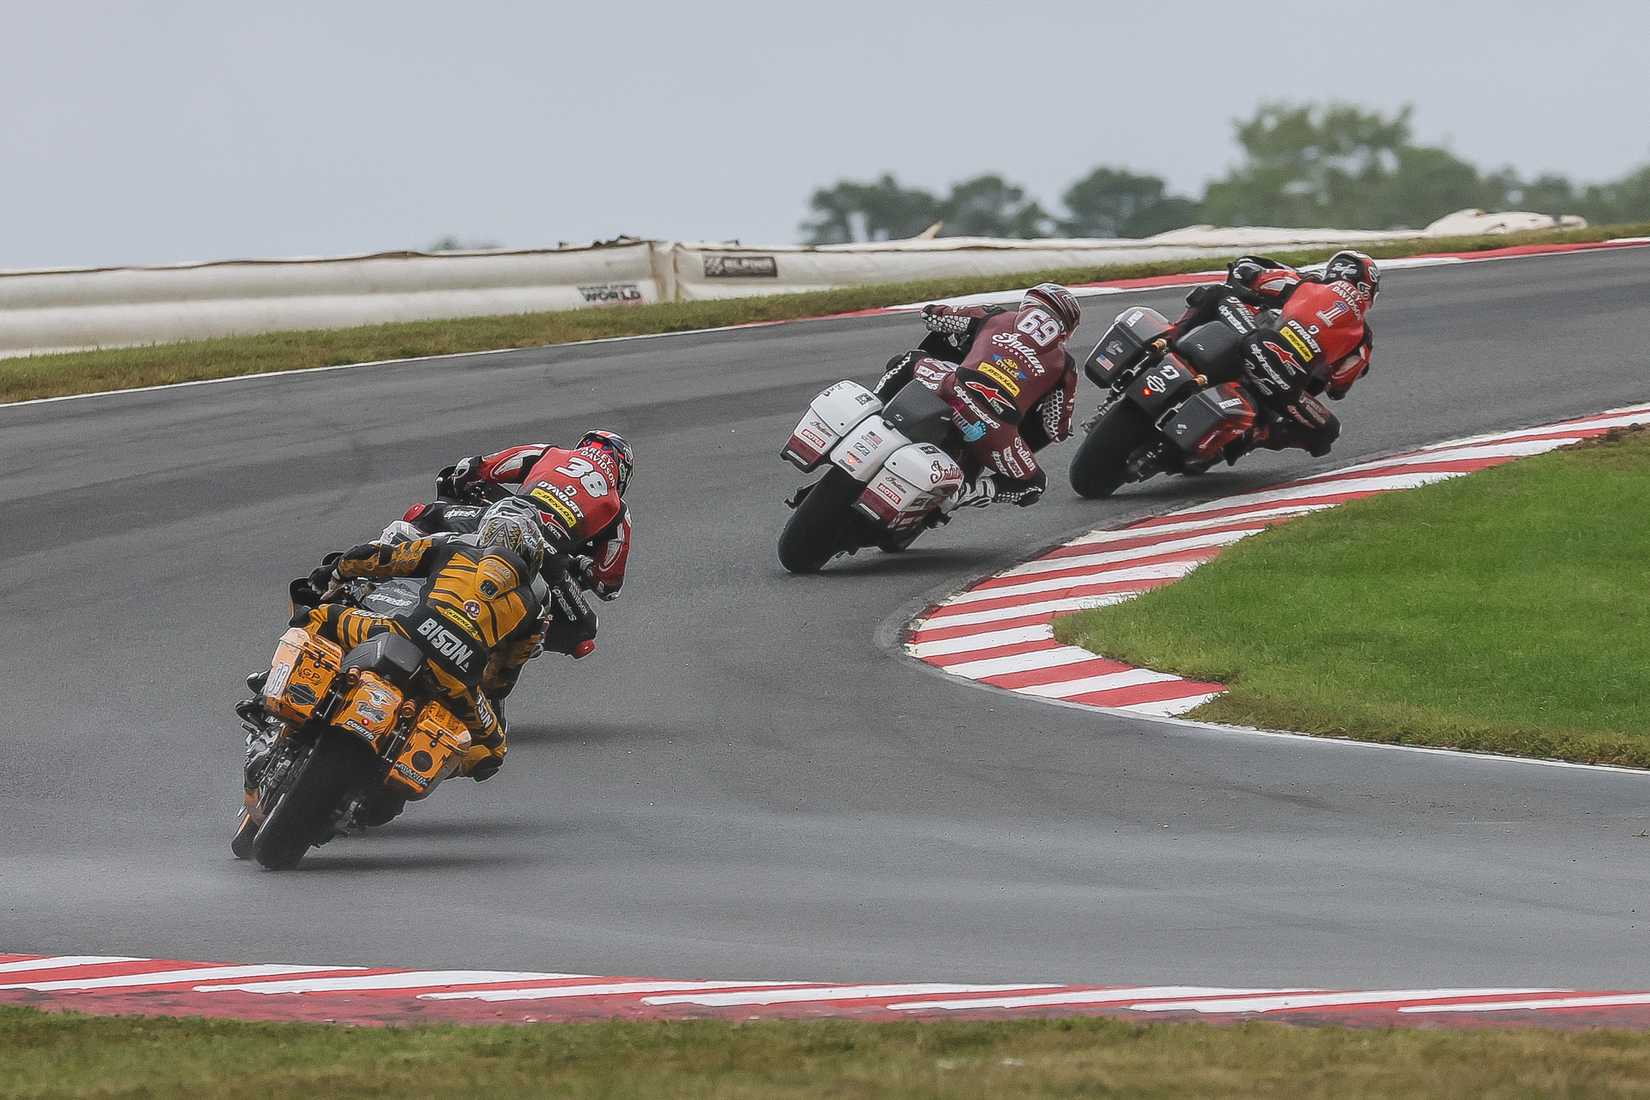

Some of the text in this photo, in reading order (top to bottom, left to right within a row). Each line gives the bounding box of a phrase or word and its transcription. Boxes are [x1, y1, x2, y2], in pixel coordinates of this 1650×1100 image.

[1017, 308, 1061, 347] 69
[992, 332, 1046, 374] Indian
[554, 456, 608, 498] 38
[878, 484, 901, 504] MOTUL
[537, 481, 584, 518] DYNOJET
[417, 618, 474, 665] BISON
